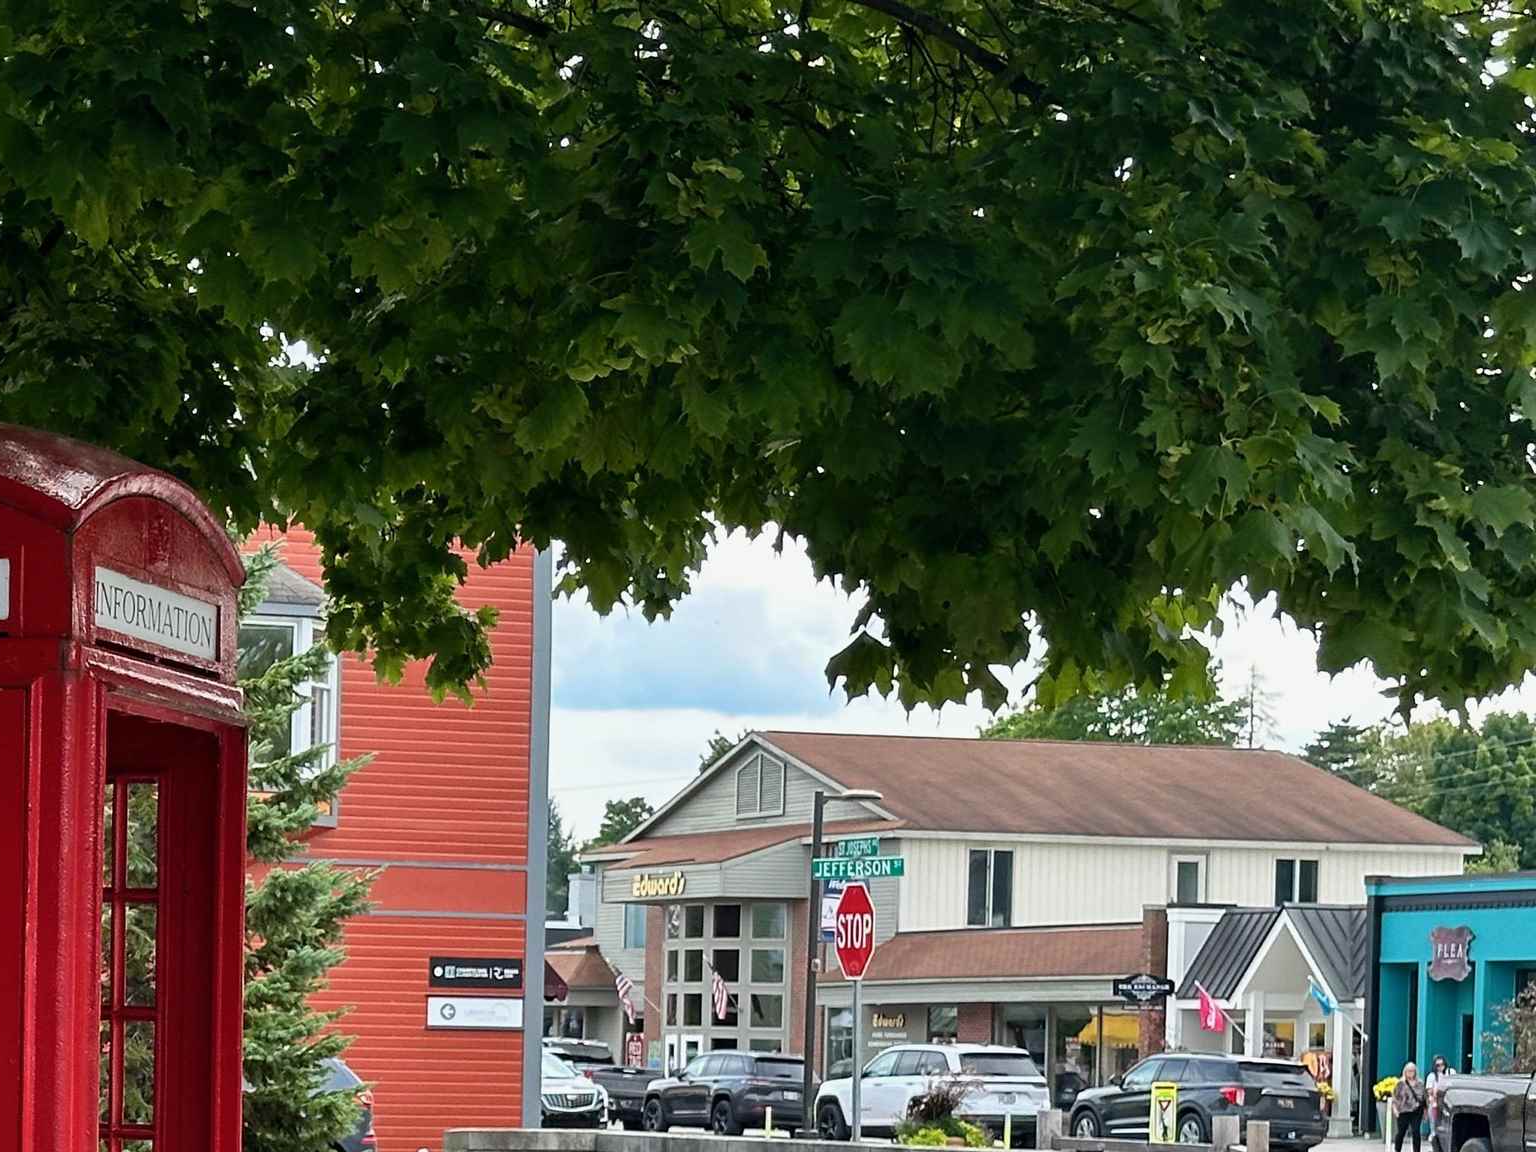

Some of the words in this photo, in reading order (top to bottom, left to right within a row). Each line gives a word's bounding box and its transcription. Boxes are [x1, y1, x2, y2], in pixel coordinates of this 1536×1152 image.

[95, 581, 212, 648] INFORMATION
[814, 860, 891, 878] JEFFERSON
[632, 870, 686, 897] Edward's
[837, 912, 872, 949] STOP
[1437, 943, 1463, 959] FLEA
